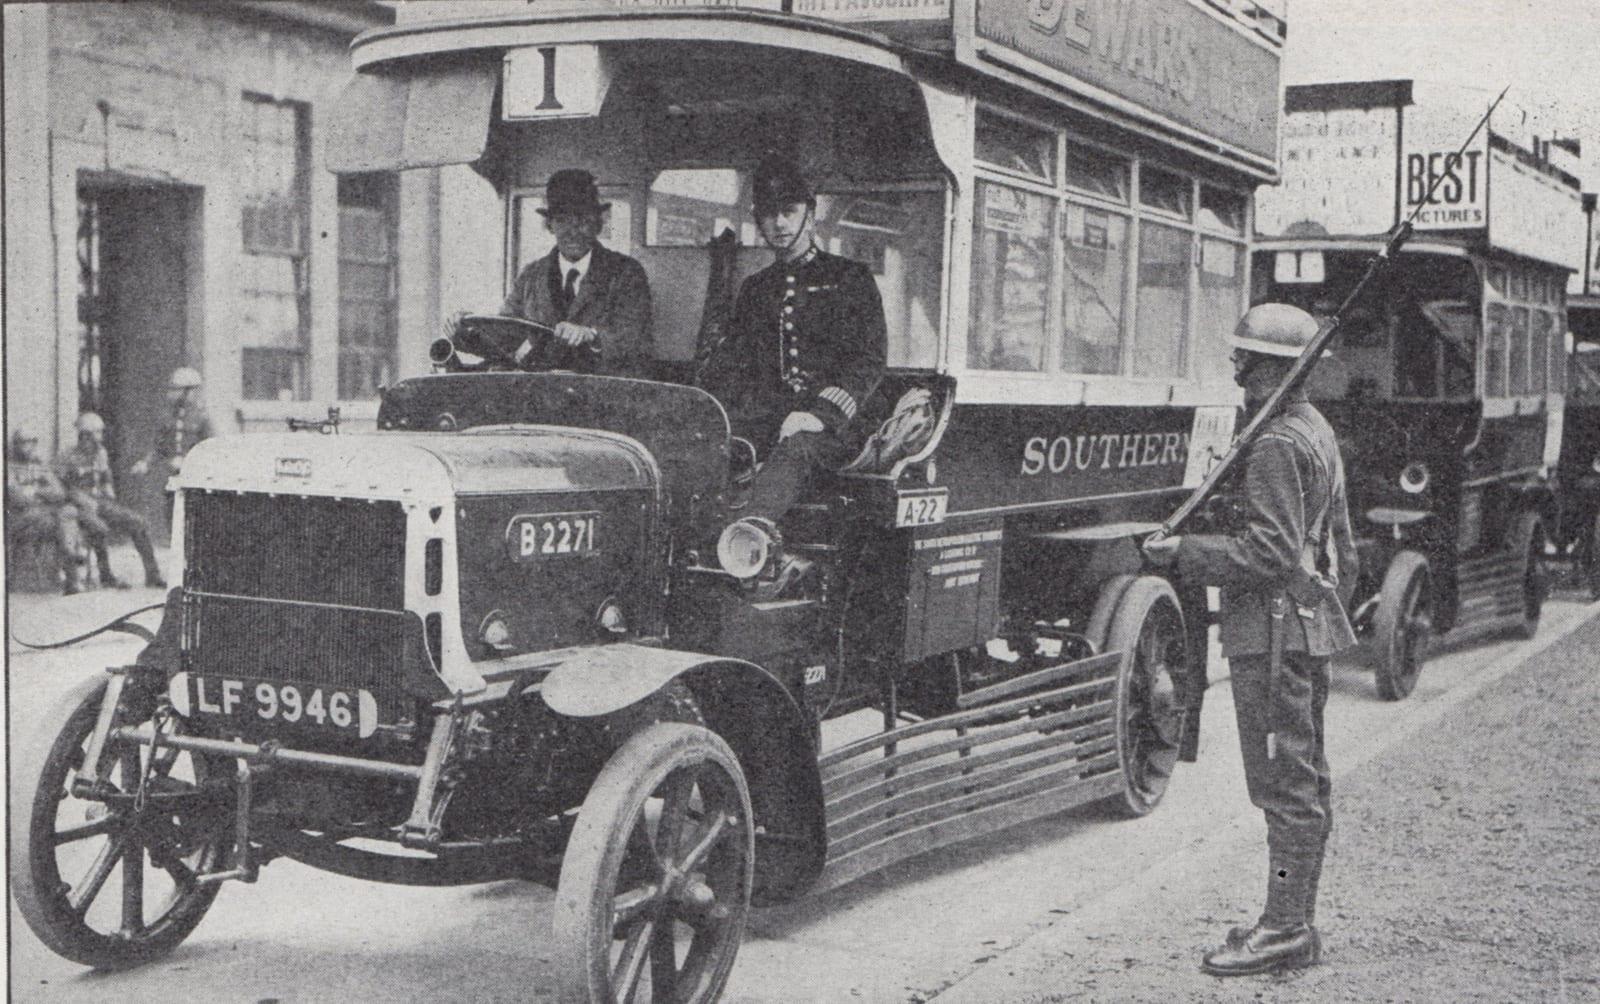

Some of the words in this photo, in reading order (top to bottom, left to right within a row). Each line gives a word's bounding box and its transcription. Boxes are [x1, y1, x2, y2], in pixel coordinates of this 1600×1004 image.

[536, 46, 563, 110] 1
[1407, 151, 1483, 206] BEST
[541, 518, 594, 554] 2271
[196, 676, 243, 715] LF
[254, 682, 353, 728] 9946
